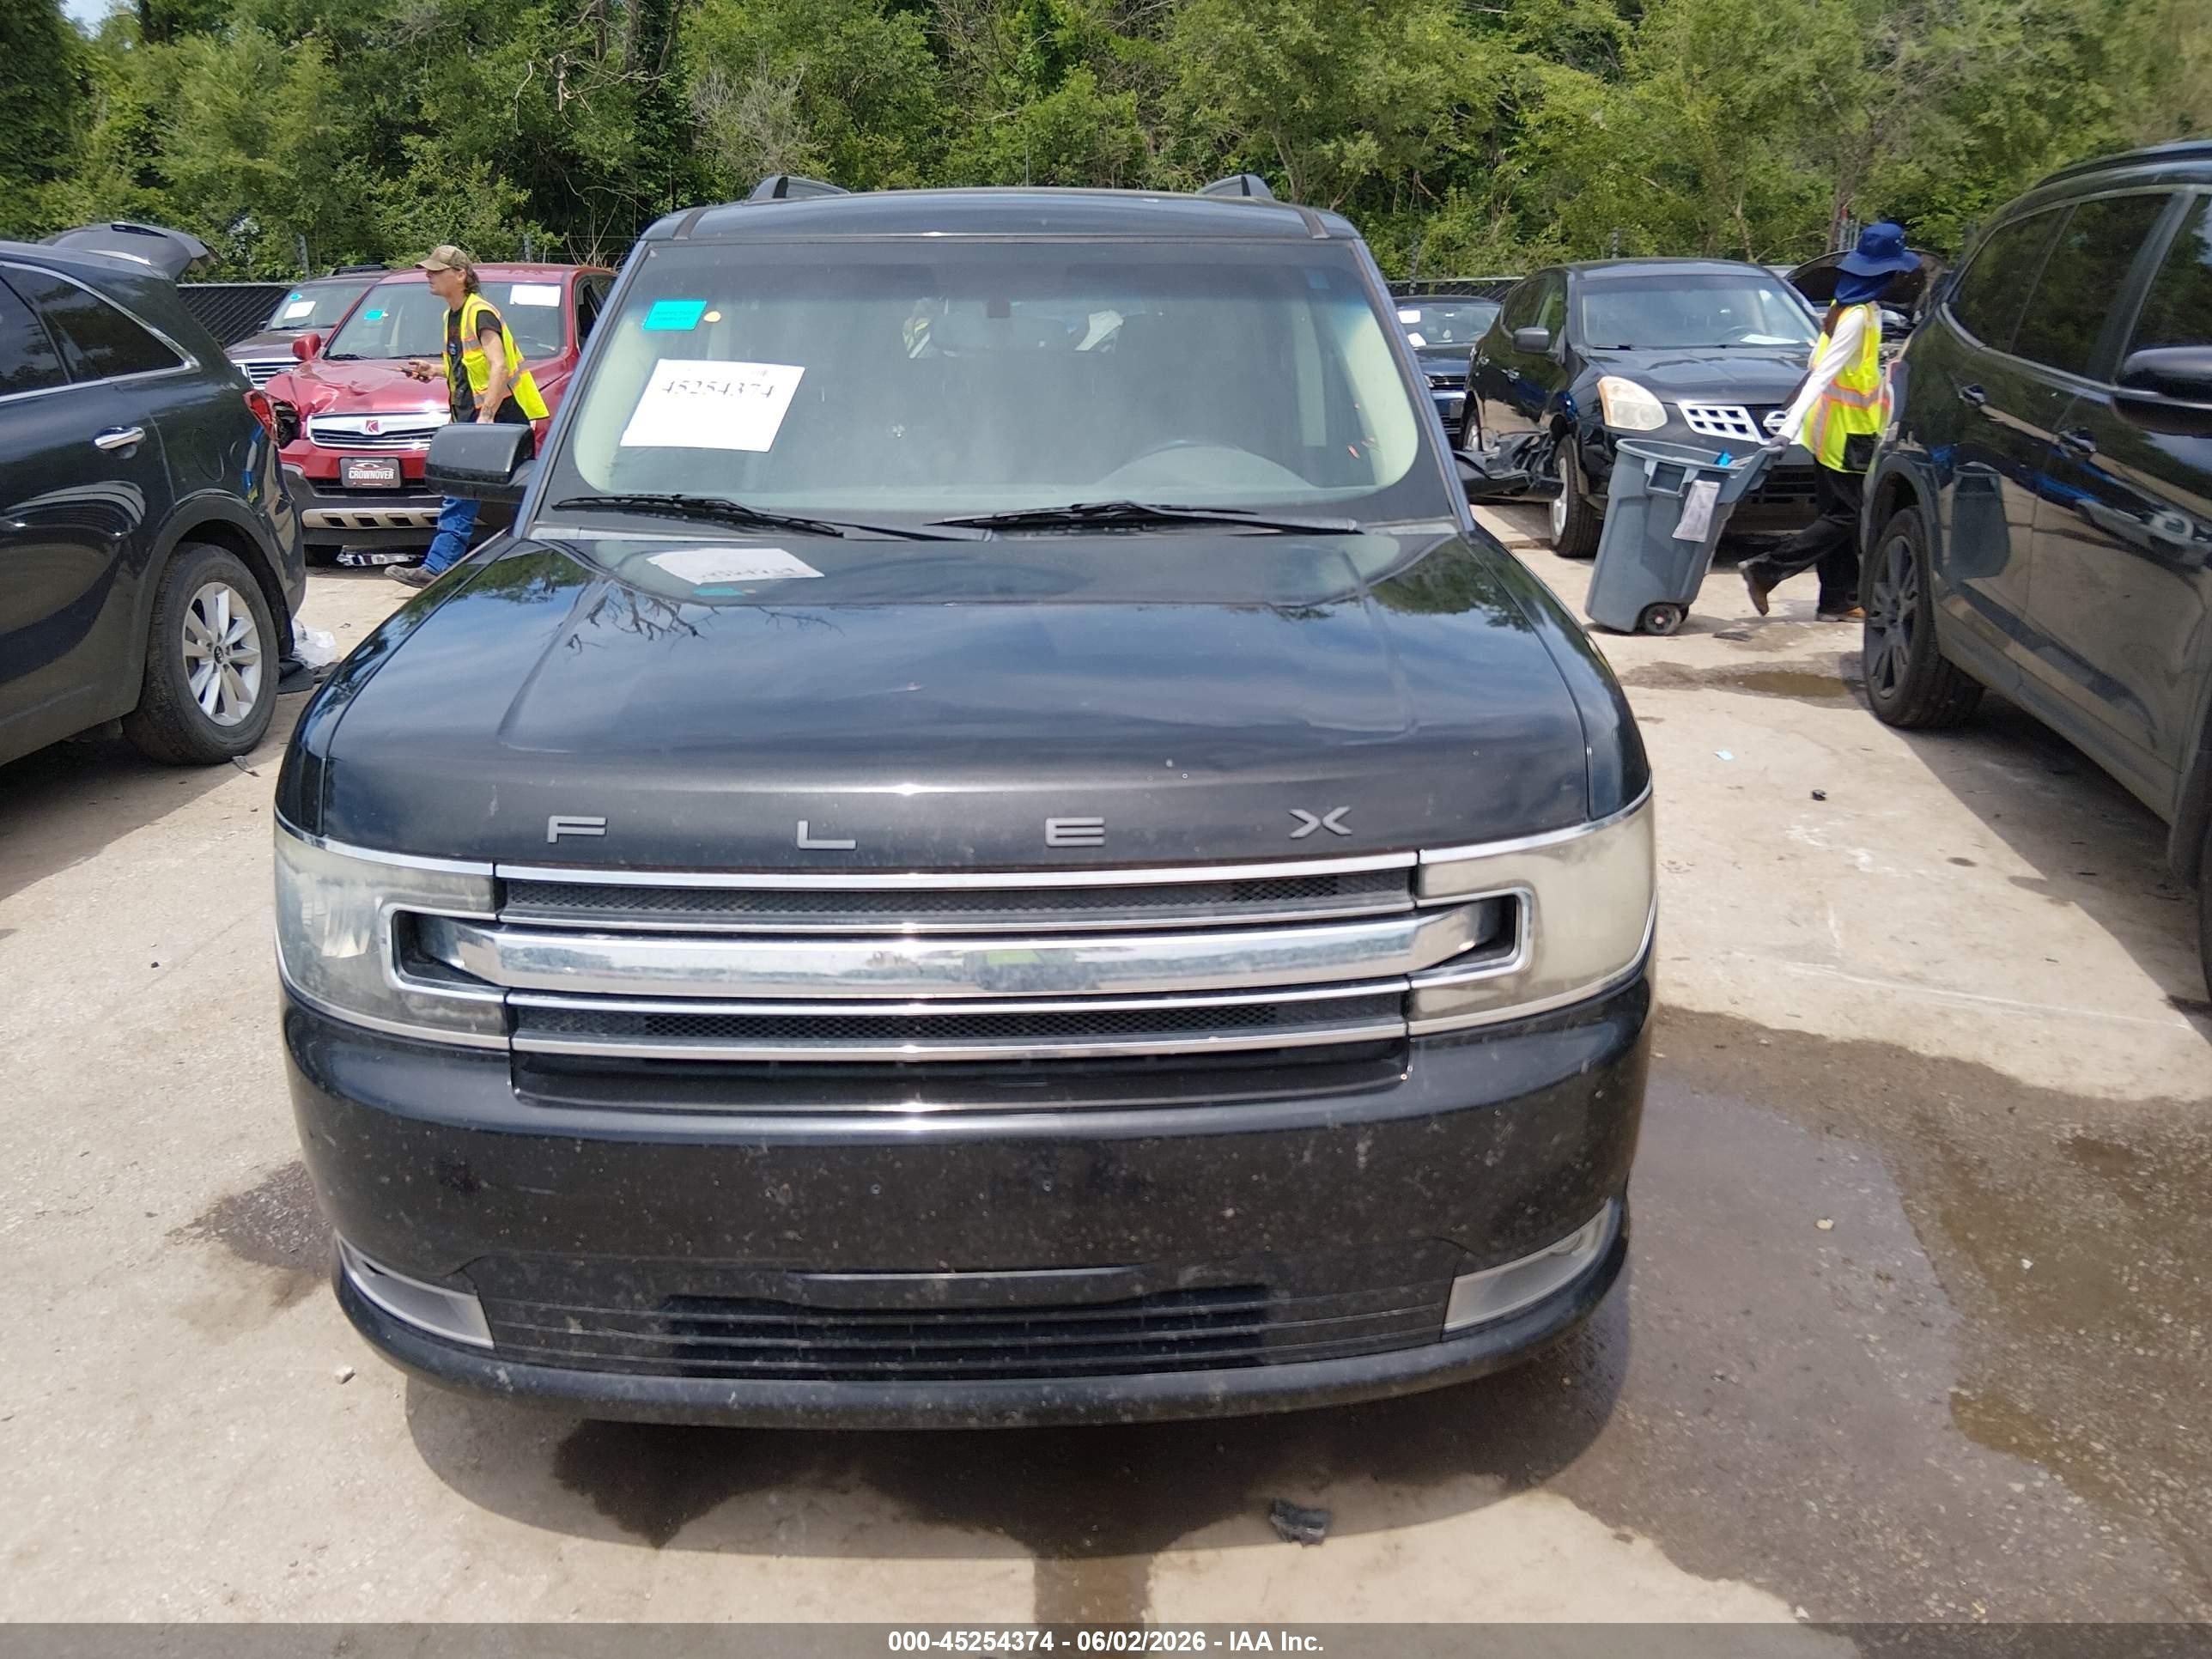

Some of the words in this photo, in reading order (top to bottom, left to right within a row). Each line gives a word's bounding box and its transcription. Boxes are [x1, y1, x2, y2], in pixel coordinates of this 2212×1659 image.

[662, 380, 775, 398] 45254374
[349, 470, 394, 480] CROWNOVER
[547, 805, 1352, 850] FLEX
